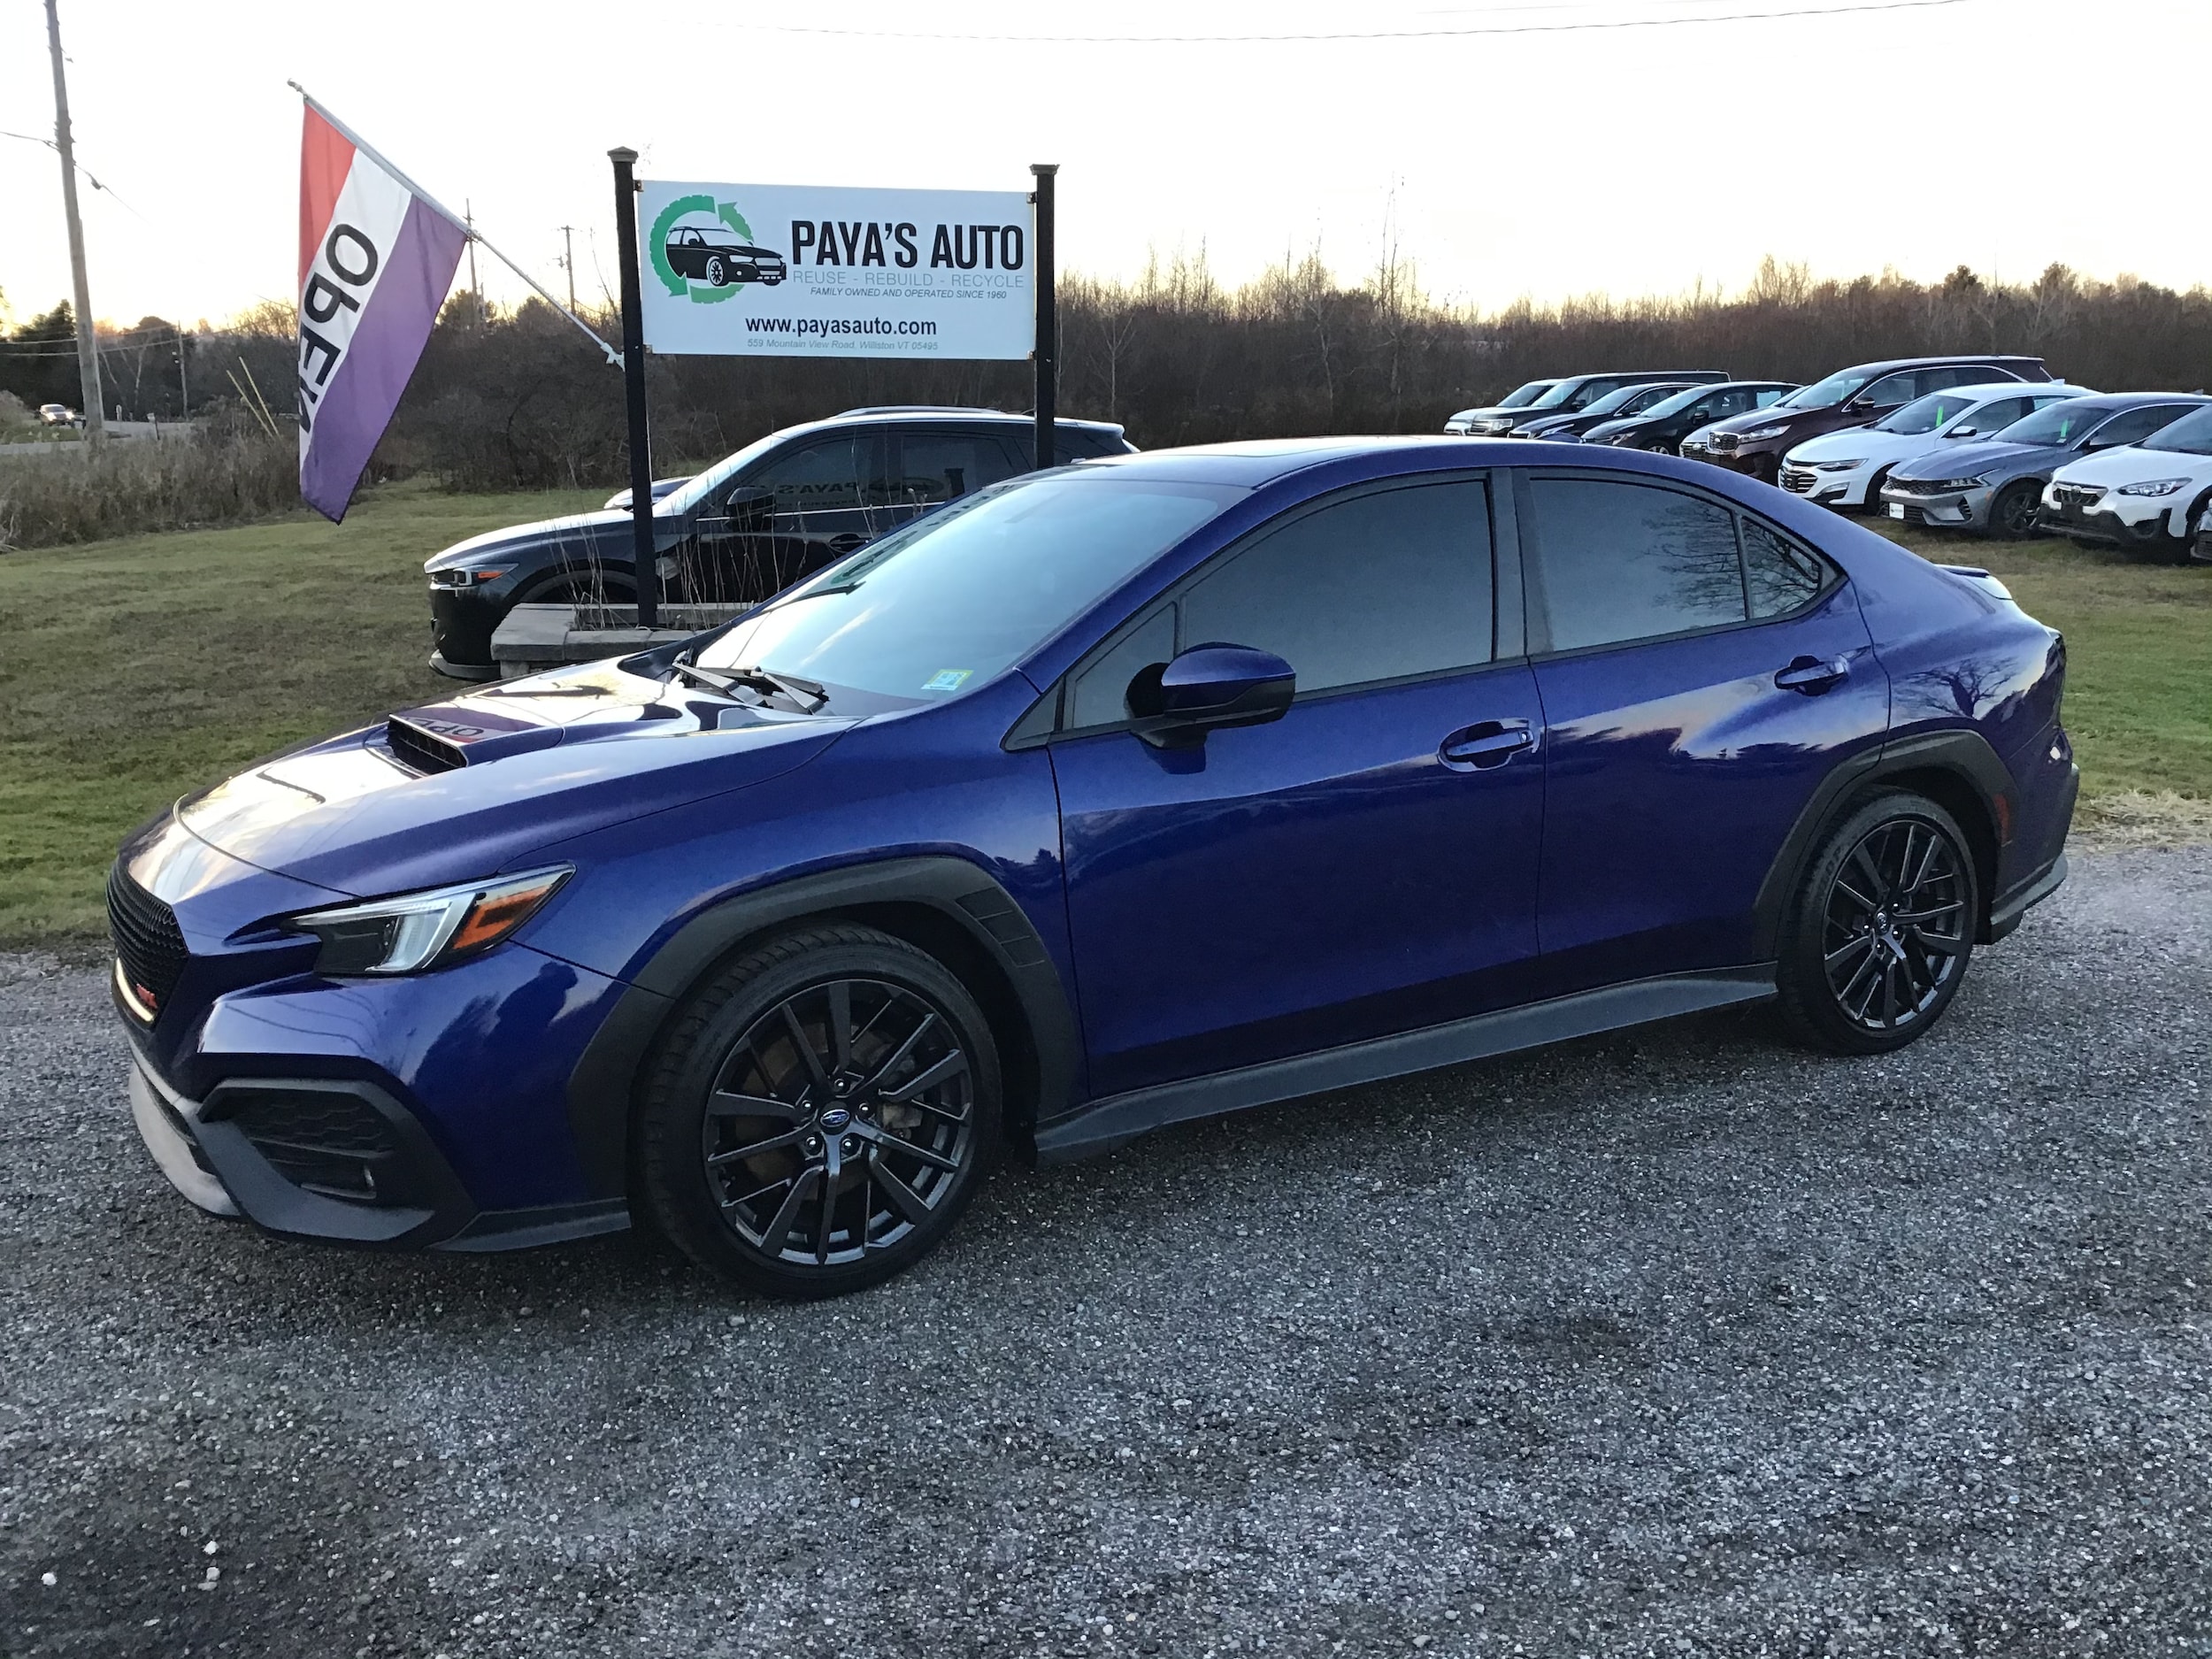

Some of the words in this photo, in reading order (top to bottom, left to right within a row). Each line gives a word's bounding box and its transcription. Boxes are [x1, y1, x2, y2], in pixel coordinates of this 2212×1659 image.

[791, 220, 918, 268] PAYA'S
[930, 224, 1024, 270] AUTO
[793, 271, 847, 284] REUSE
[865, 273, 933, 286] REBUILD
[951, 274, 1024, 288] RECYCLE
[810, 288, 844, 296] FAMILY
[845, 288, 881, 297] OWNED
[882, 288, 902, 297] AND
[904, 288, 954, 298] OPERATED
[956, 290, 984, 299] SINCE
[987, 290, 1007, 299] 1960
[745, 317, 937, 338] www.payasauto.com
[748, 339, 764, 348] 559
[766, 339, 806, 349] Mountain
[808, 340, 829, 349] View
[859, 341, 895, 349] Williston
